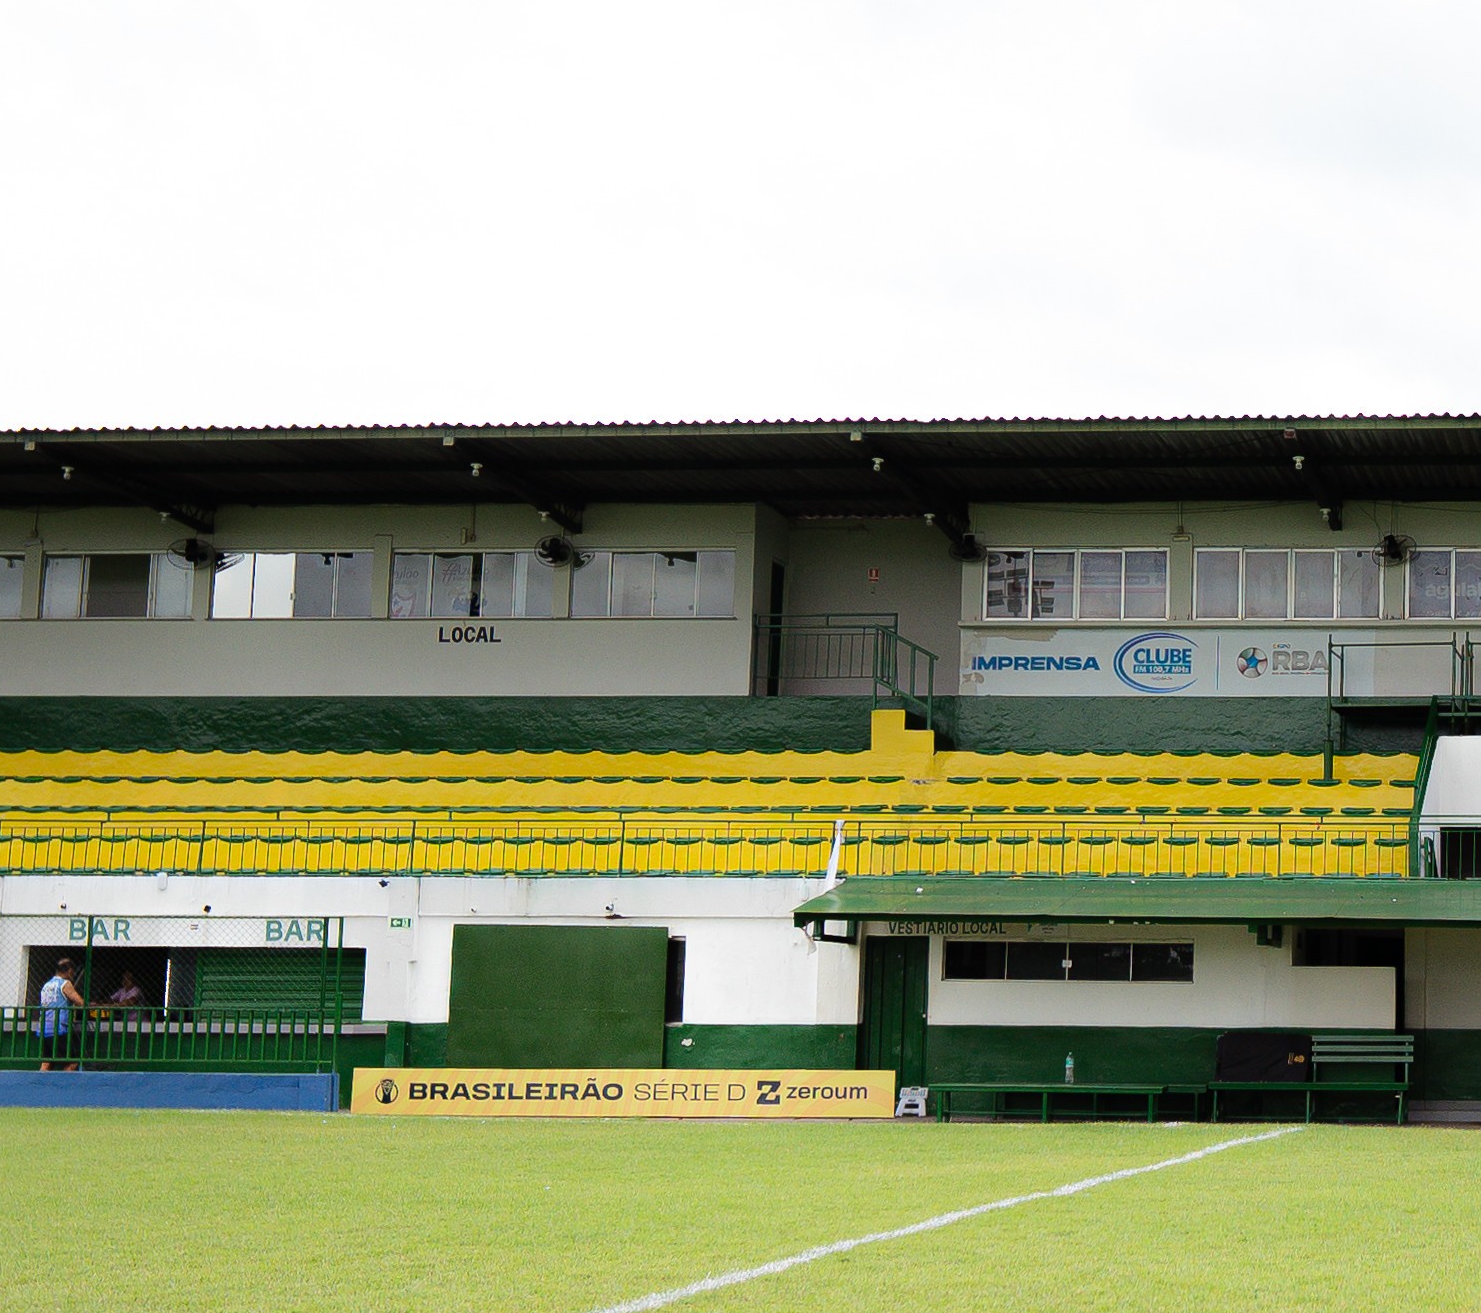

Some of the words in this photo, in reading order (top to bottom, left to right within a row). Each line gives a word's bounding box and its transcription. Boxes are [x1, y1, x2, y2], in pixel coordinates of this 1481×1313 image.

[438, 626, 501, 643] LOCAL
[972, 656, 1100, 671] IMPRENSA
[1133, 648, 1192, 664] CLUBE
[1272, 650, 1330, 671] RBA
[69, 919, 131, 941] BAR
[265, 919, 323, 942] BAR
[963, 922, 1006, 934] LOCAL
[409, 1077, 623, 1101] BRASILEIRÃO
[634, 1079, 720, 1101] SÉRIE
[727, 1084, 746, 1101] D
[786, 1085, 868, 1100] zeroum
